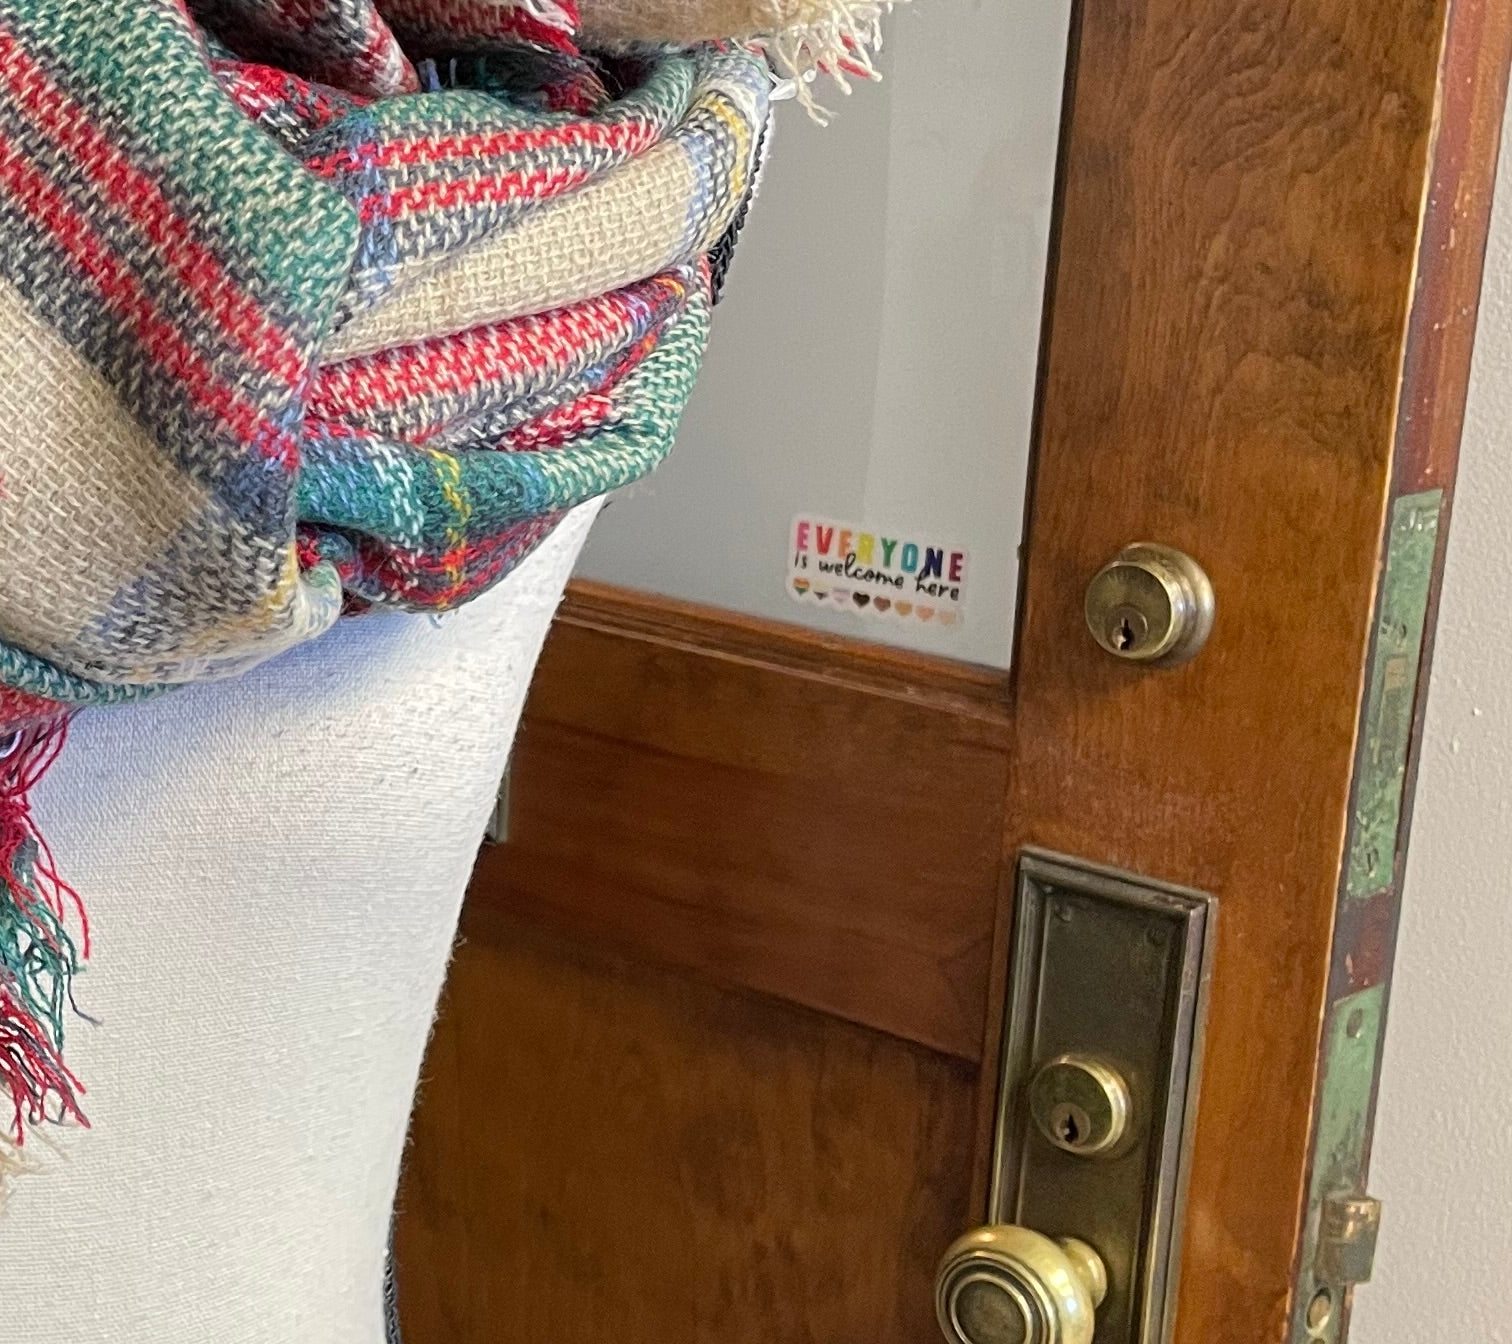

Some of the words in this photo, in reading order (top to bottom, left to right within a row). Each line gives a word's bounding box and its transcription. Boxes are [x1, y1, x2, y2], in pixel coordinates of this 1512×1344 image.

[796, 521, 963, 583] EVERYONE
[818, 552, 905, 589] welcome
[915, 568, 960, 601] here
